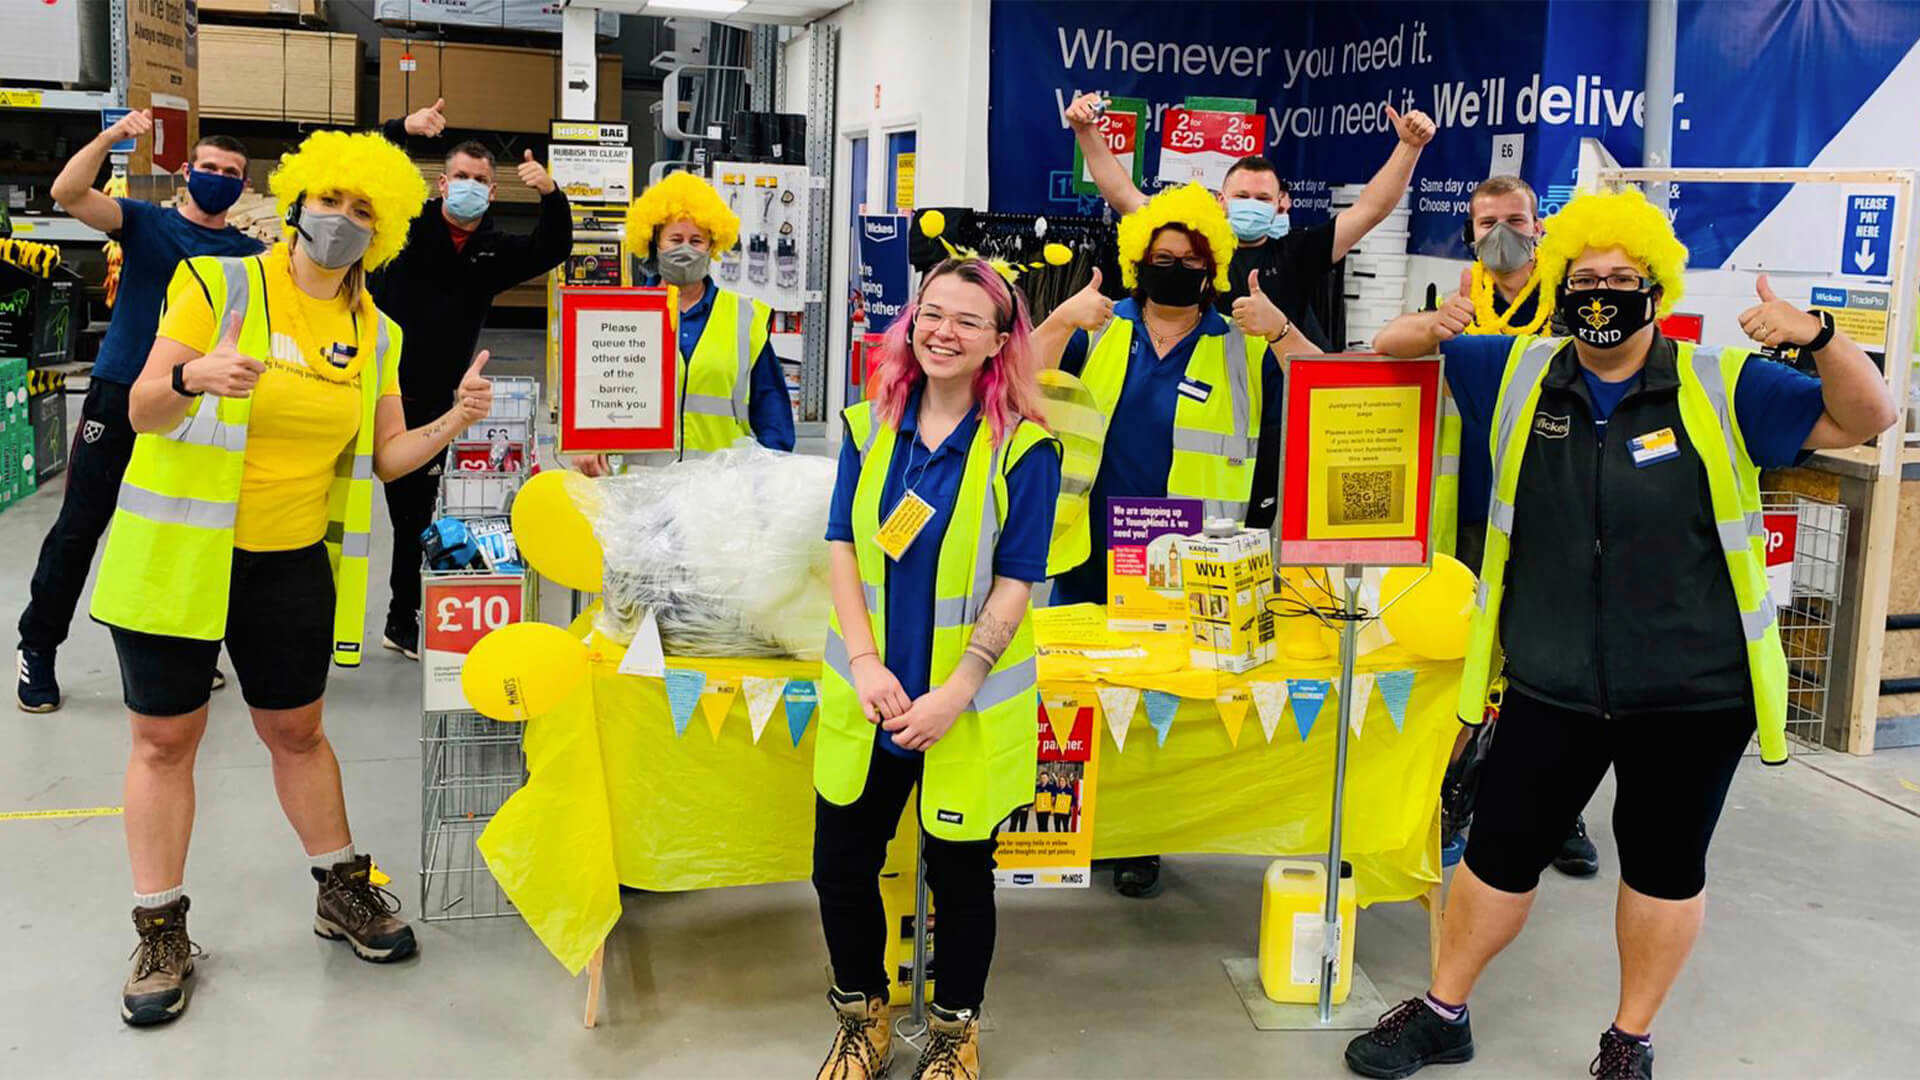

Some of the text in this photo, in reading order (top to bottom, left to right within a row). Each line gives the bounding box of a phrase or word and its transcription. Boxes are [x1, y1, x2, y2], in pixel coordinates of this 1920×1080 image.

[1058, 21, 1432, 88] Whenever you need it.
[1269, 105, 1324, 147] you
[1331, 89, 1392, 134] need
[1433, 77, 1505, 128] We'll
[1100, 116, 1111, 132] 2
[1177, 113, 1202, 130] 2 for
[1227, 117, 1253, 133] 2 for
[600, 128, 624, 138] BAG
[1170, 130, 1204, 149] £25
[1221, 134, 1256, 152] £30
[1501, 143, 1514, 158] £6
[1420, 178, 1443, 192] Same
[1445, 178, 1464, 196] day
[1419, 197, 1450, 212] Choose
[1854, 198, 1888, 210] PLEASE
[1860, 212, 1879, 223] PAY
[1856, 226, 1880, 238] HERE
[601, 323, 637, 333] Please
[1578, 328, 1622, 343] KIND
[592, 340, 646, 349] queue the
[592, 354, 646, 363] other side
[603, 369, 634, 378] of the
[590, 399, 647, 410] Thank you
[1113, 505, 1182, 518] We are stepping up
[1113, 517, 1124, 526] for
[1178, 520, 1189, 528] we
[1113, 529, 1132, 538] need
[1195, 563, 1226, 578] WV1
[437, 595, 511, 632] £10
